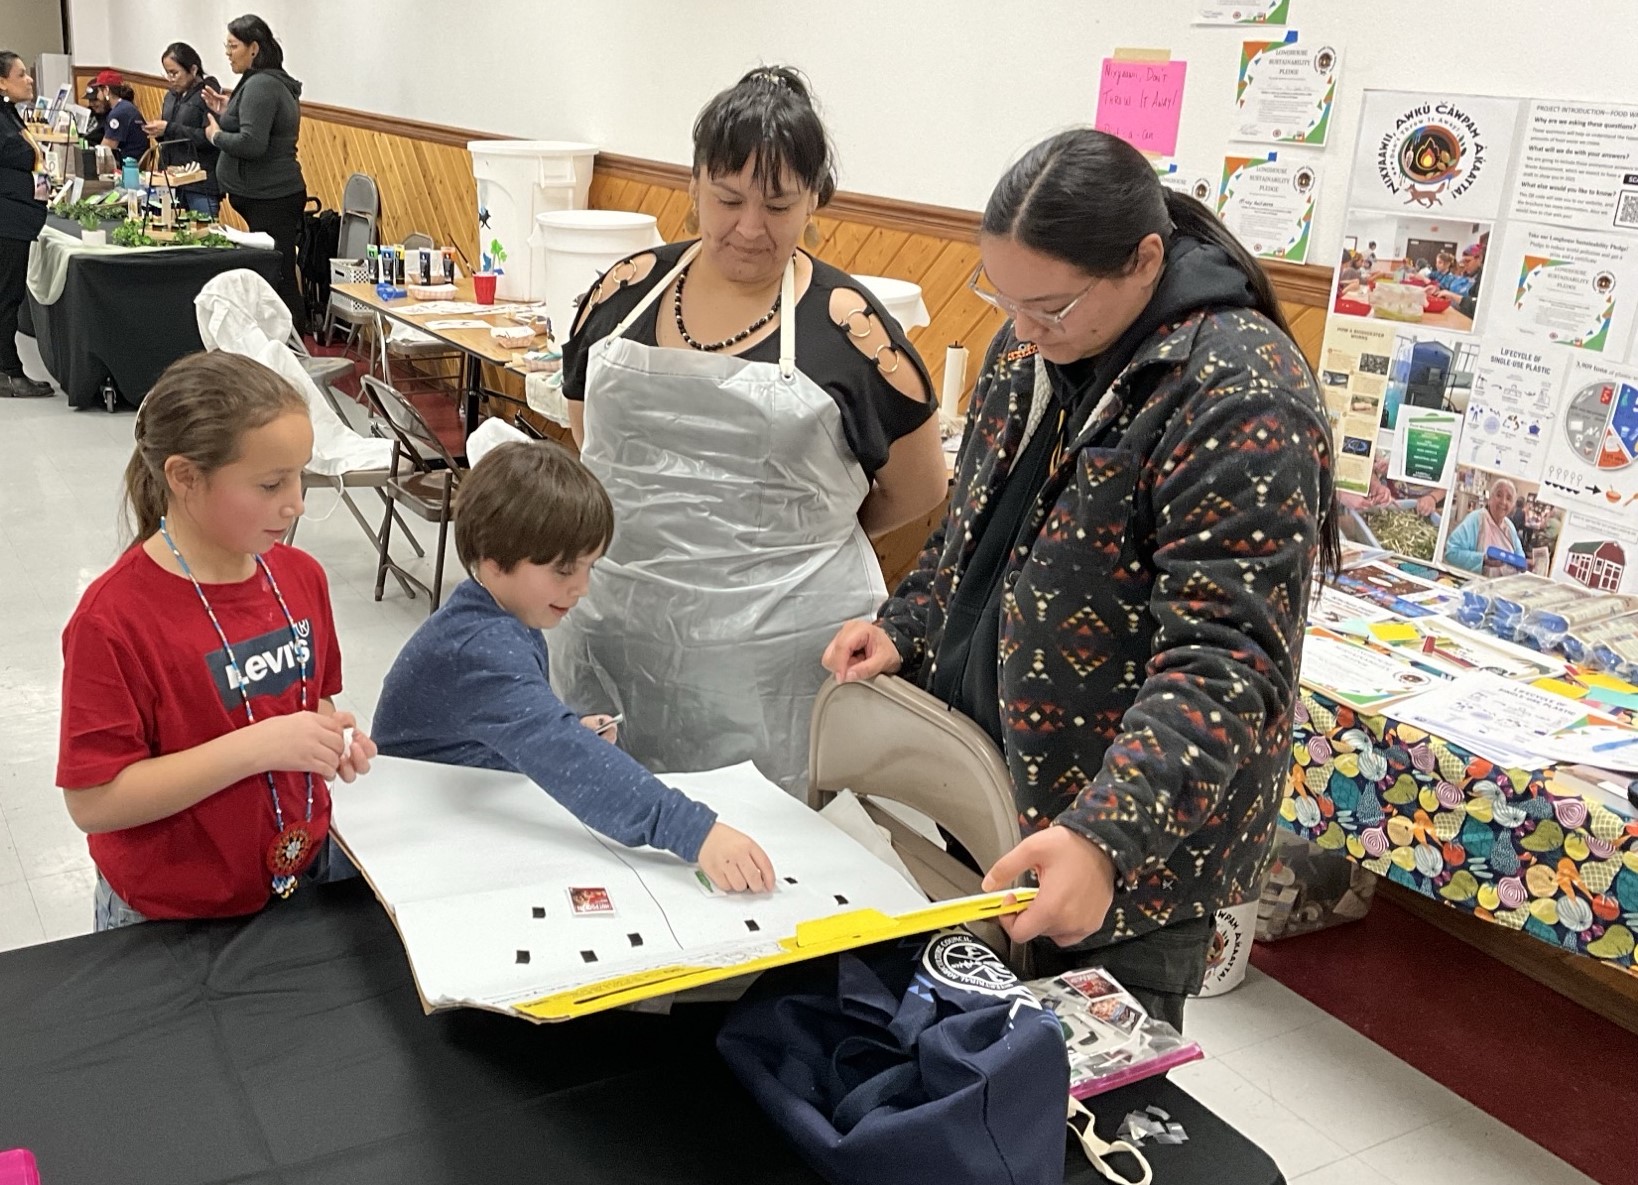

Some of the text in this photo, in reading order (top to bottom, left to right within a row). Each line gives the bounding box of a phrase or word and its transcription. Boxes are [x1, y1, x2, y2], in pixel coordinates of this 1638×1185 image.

[1268, 58, 1311, 66] SUSTAINABILITY
[1534, 116, 1547, 124] Why
[1568, 120, 1586, 128] asking
[1604, 122, 1637, 130] questions?
[1256, 166, 1288, 174] LONGHOUSE
[1249, 175, 1290, 184] SUSTAINABILITY
[1549, 235, 1575, 244] Longhouse
[1576, 239, 1609, 249] Sustainability
[1610, 243, 1629, 252] Pledge!
[1501, 347, 1542, 363] LIFECYCLE OF
[1490, 355, 1551, 375] SINGLE-USE PLASTIC
[225, 639, 310, 690] Levi's
[1543, 702, 1576, 716] PLASTIC
[940, 936, 972, 947] COUNCIL
